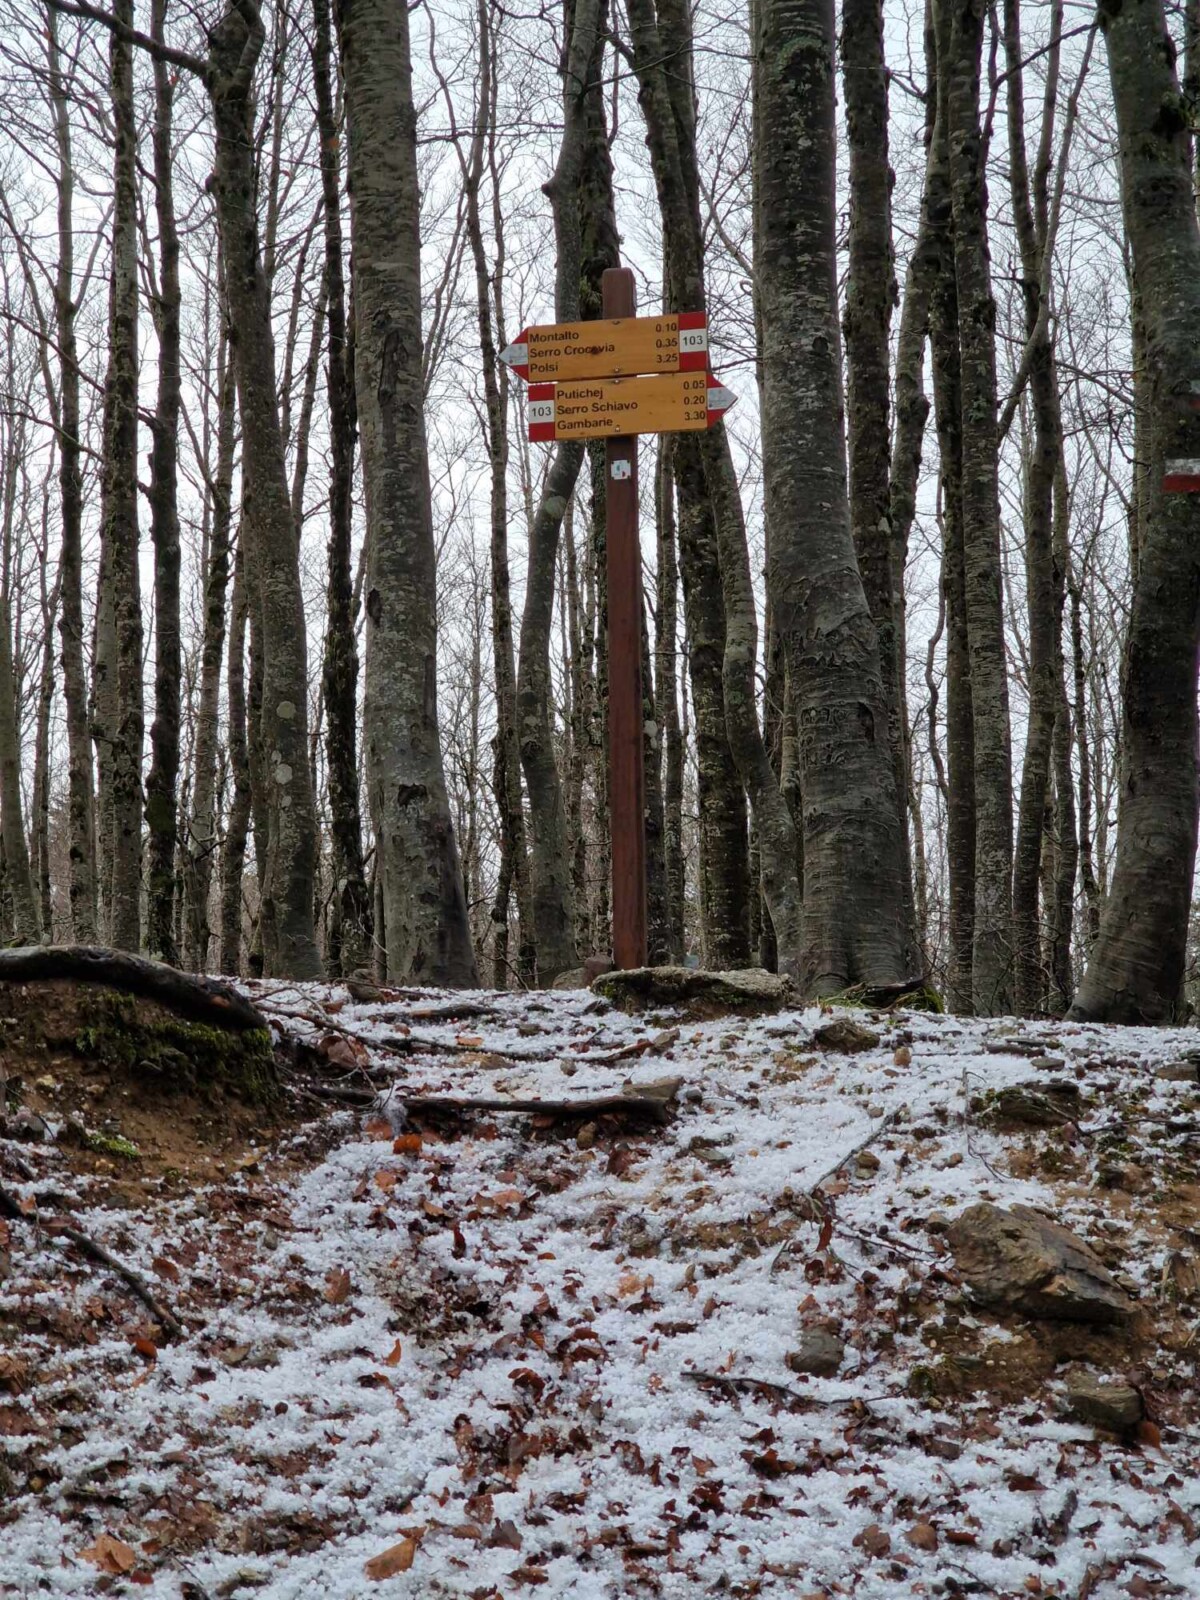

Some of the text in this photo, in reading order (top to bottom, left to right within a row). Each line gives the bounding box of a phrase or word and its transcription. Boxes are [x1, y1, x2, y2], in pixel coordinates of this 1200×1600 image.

[655, 322, 677, 333] 0.10
[529, 331, 579, 342] Montalto
[683, 335, 703, 345] 103
[655, 338, 678, 349] 0.35
[529, 348, 561, 358] Serro
[564, 343, 615, 355] Crocvia
[656, 353, 678, 364] 3.25
[530, 362, 559, 372] Polsi
[683, 380, 705, 390] 0.05
[556, 387, 603, 400] Putichej
[684, 396, 706, 406] 0.20
[532, 406, 552, 417] 103
[557, 401, 638, 415] Serro Schiavo
[684, 411, 706, 421] 3.30
[557, 418, 613, 430] Gambarie
